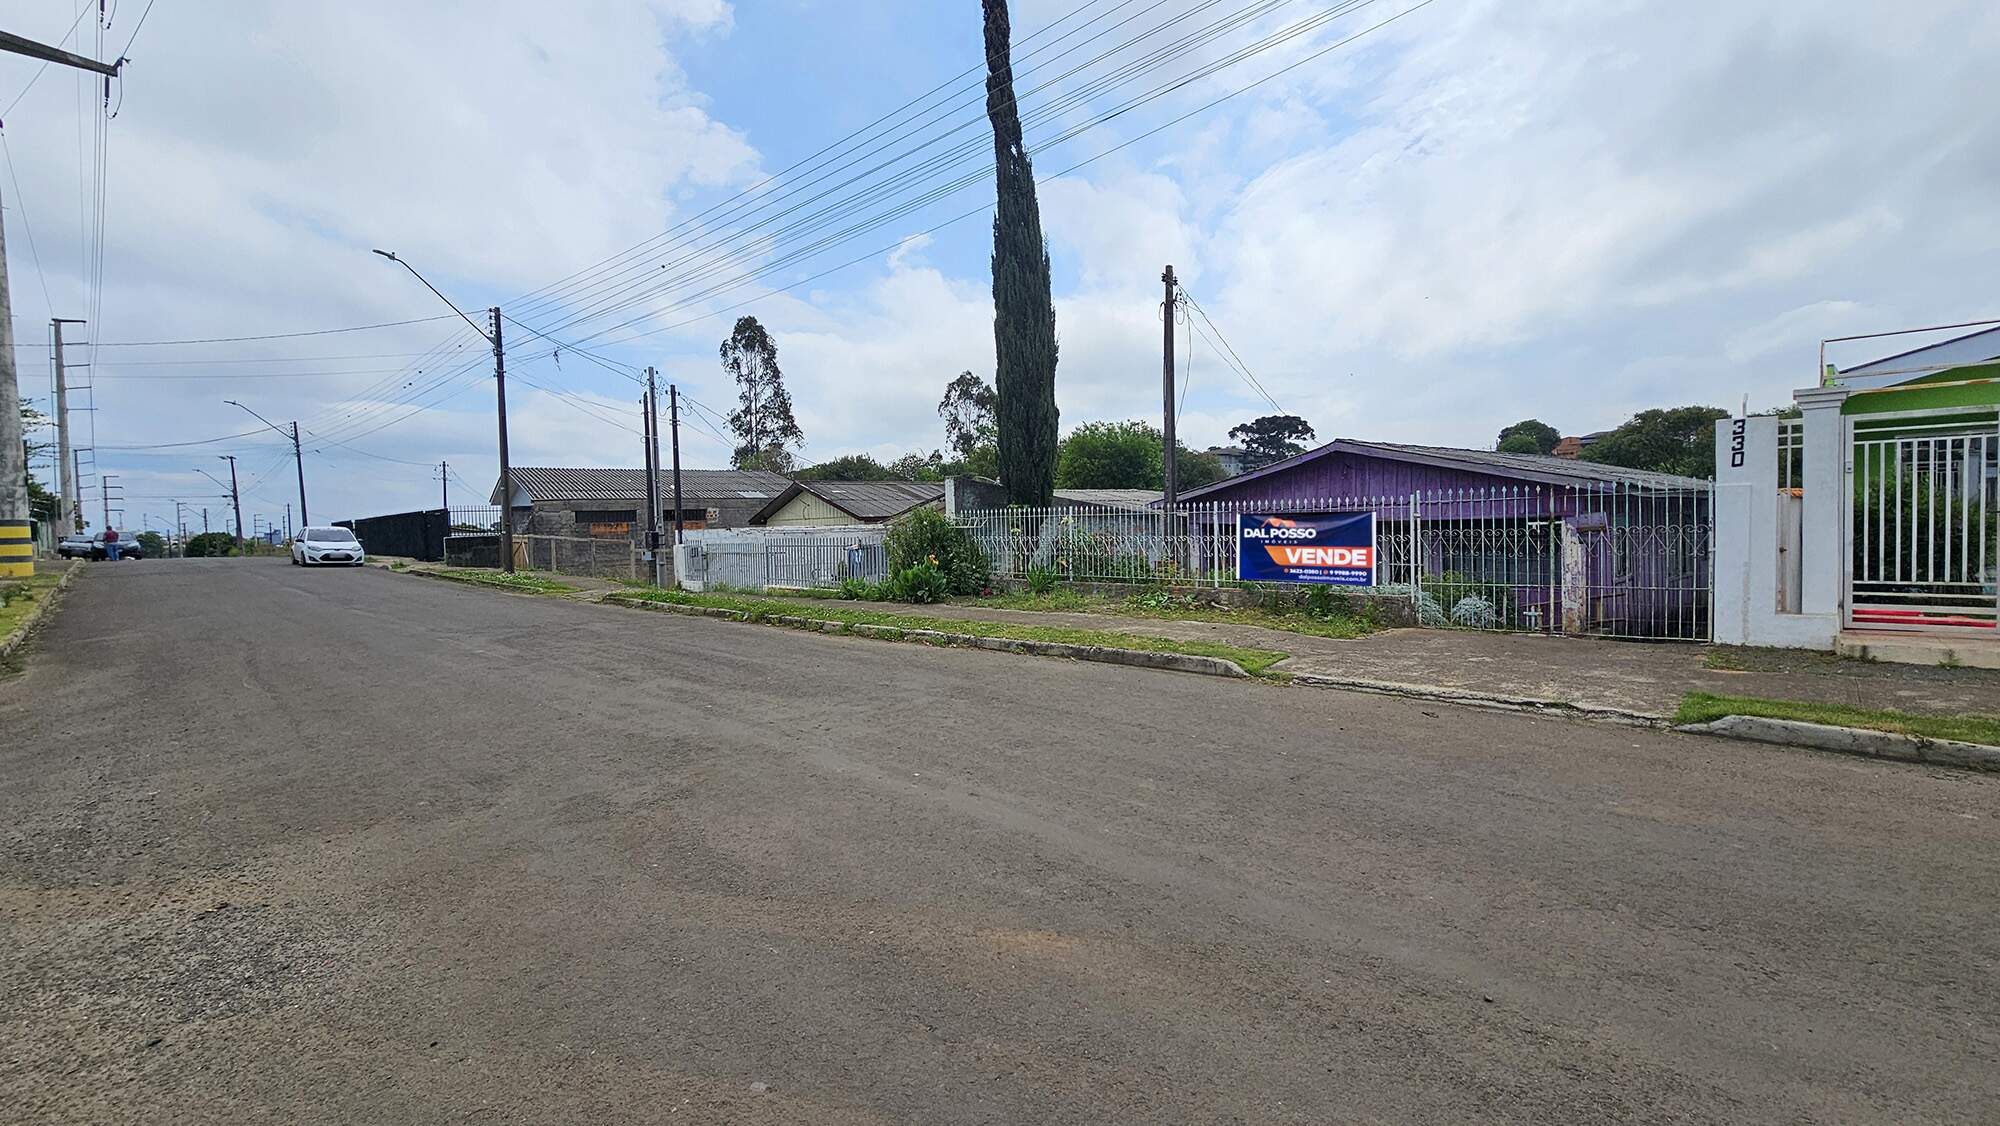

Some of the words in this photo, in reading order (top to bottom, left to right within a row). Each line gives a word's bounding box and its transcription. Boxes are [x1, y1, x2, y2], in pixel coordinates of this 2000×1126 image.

[1731, 418, 1746, 468] 330
[1244, 528, 1269, 538] DAL
[1270, 528, 1316, 538] POSSO
[1285, 548, 1367, 566] VENDE
